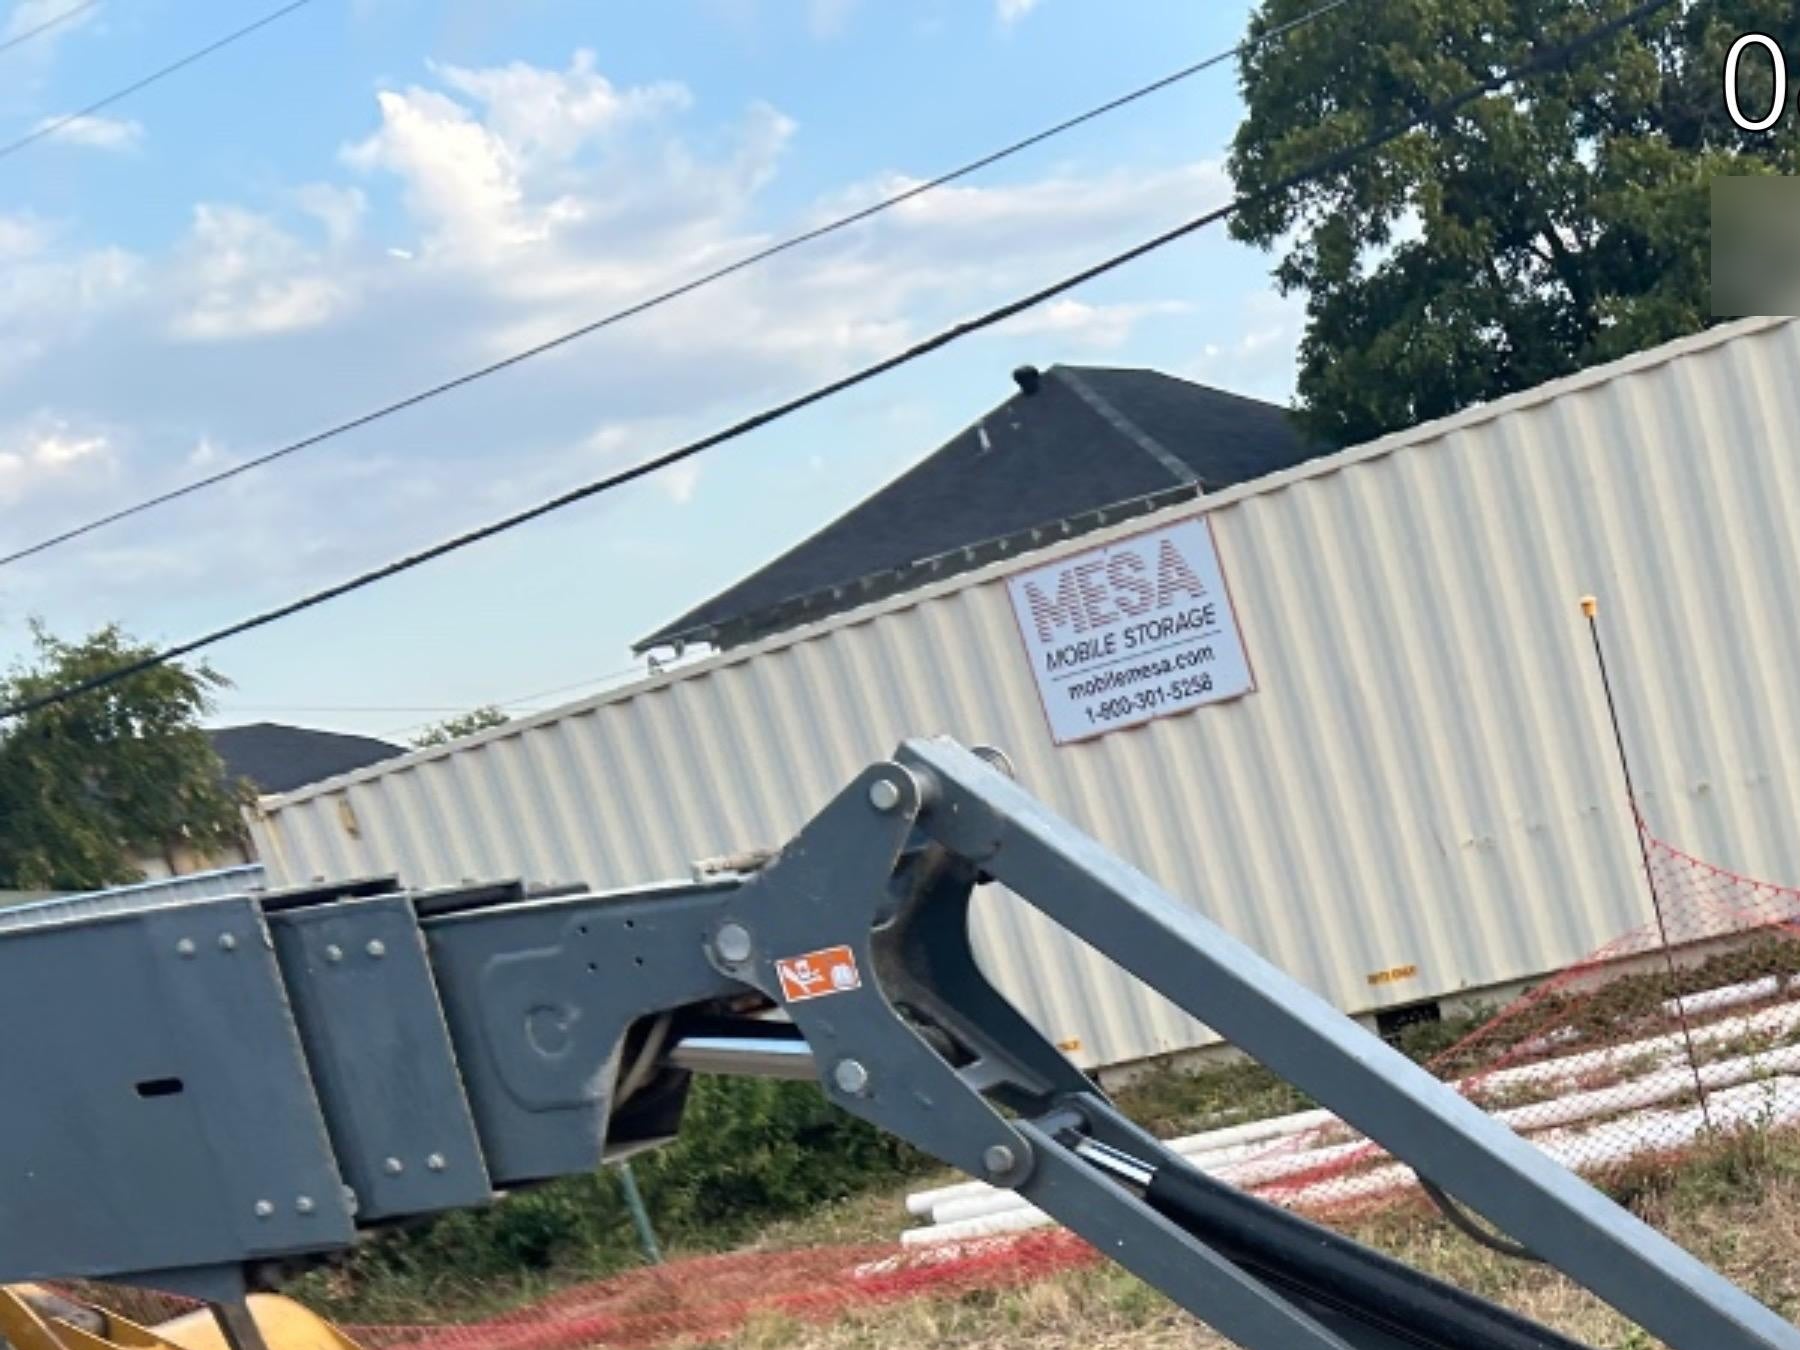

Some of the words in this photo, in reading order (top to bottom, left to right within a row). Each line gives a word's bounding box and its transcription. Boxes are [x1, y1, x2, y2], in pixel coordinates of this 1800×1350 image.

[1024, 538, 1206, 643] MESA
[1046, 631, 1116, 673] MOBILE
[1124, 602, 1216, 649] STORAGE
[1067, 645, 1216, 700] mobilemesa.com
